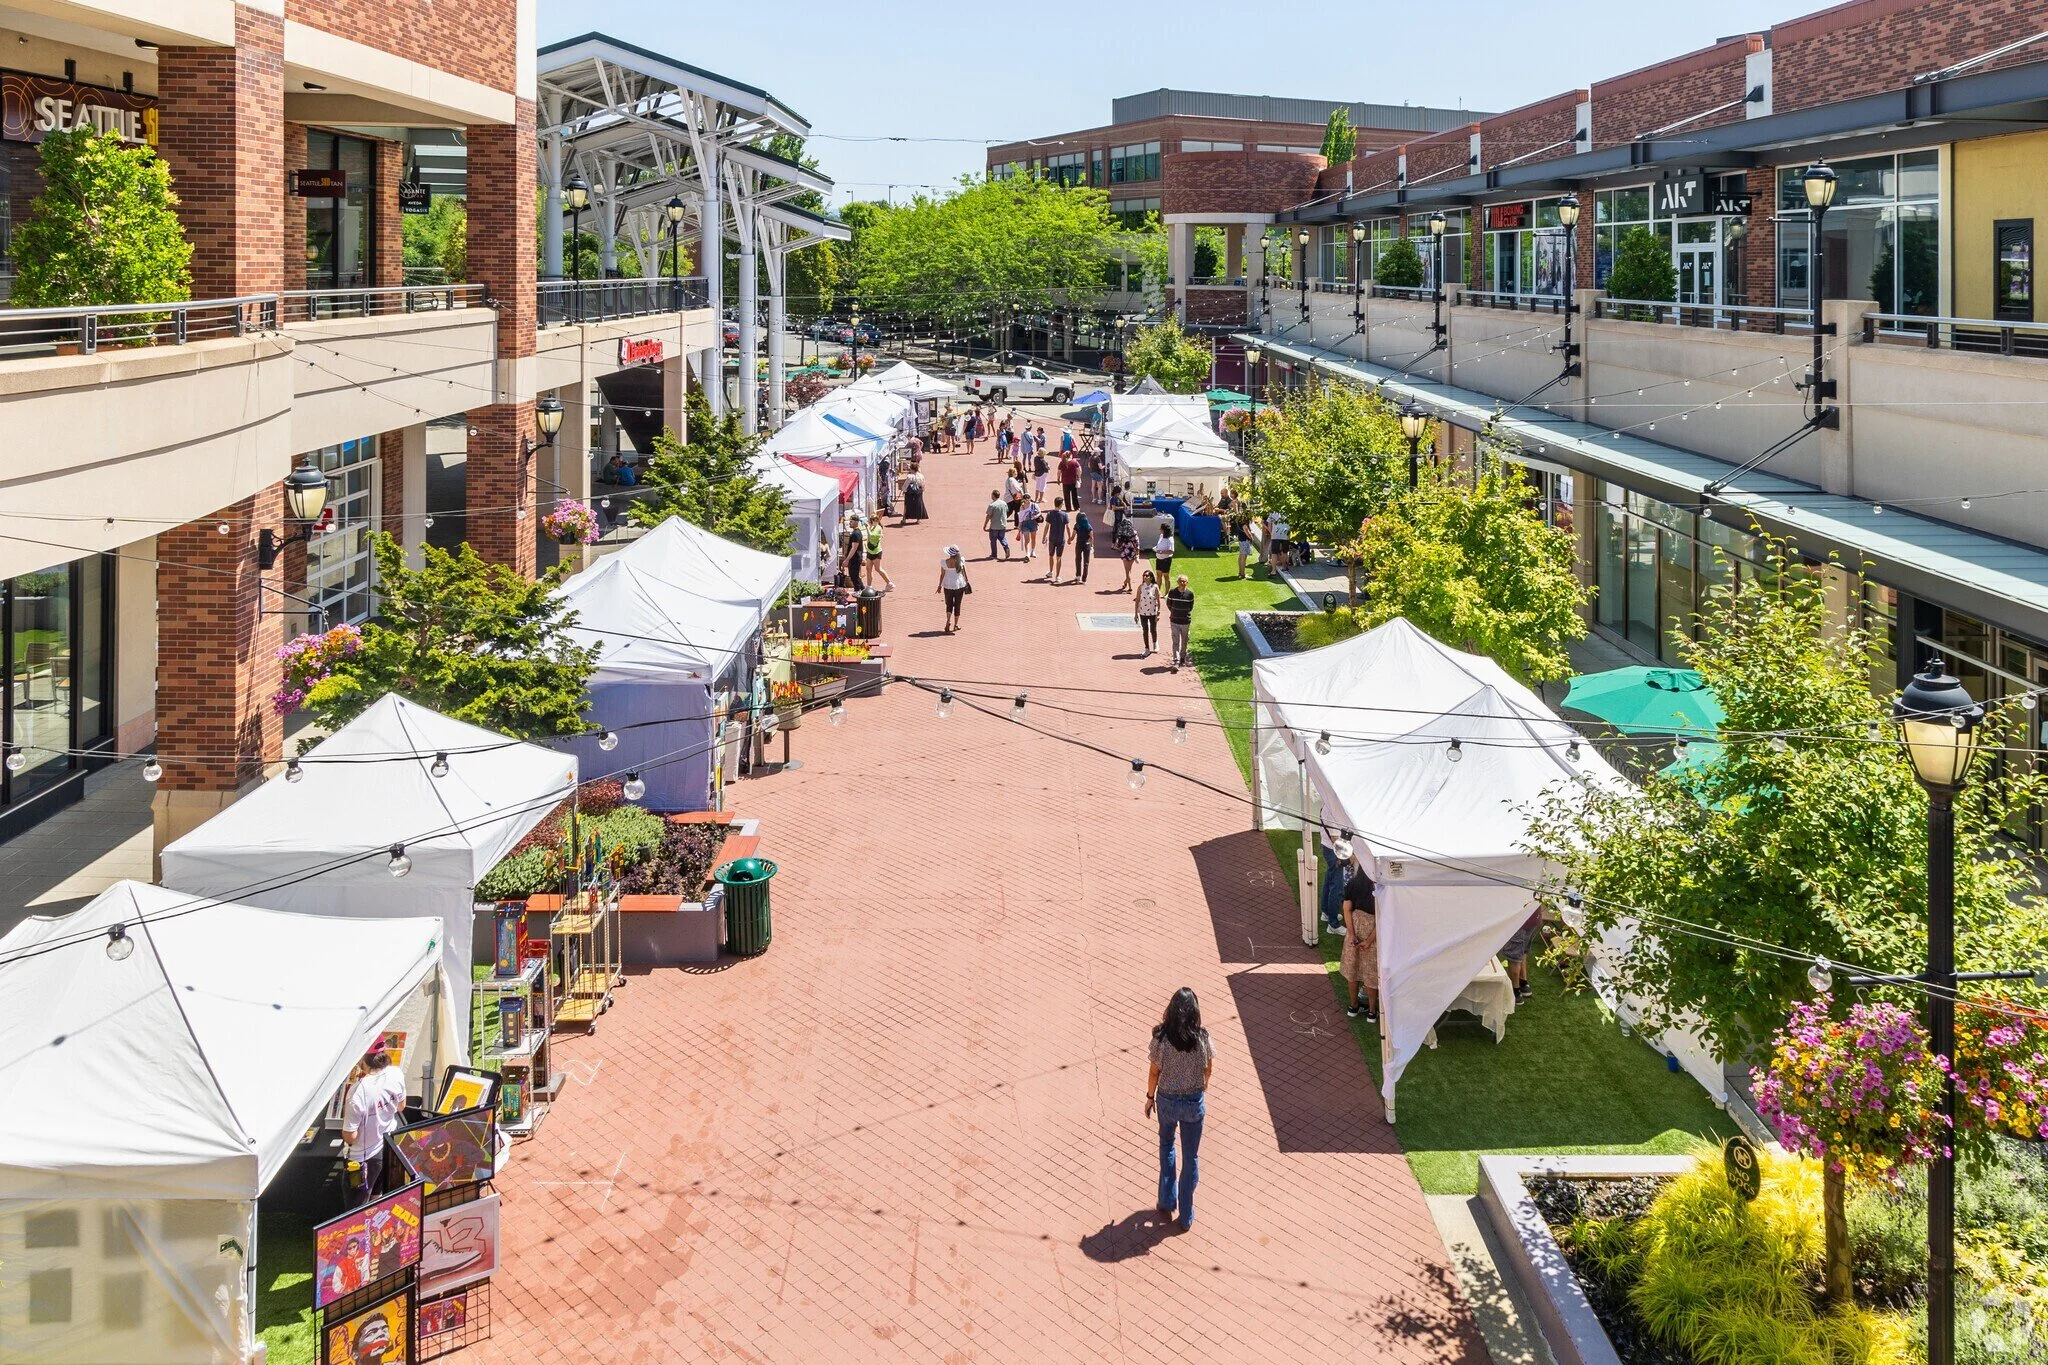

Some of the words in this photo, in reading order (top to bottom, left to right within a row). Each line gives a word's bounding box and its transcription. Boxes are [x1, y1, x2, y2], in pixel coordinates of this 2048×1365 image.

[34, 96, 148, 144] SEATTLE
[1503, 203, 1524, 216] BOXING
[1503, 216, 1518, 227] CLUB
[1735, 1166, 1750, 1182] NO
[1729, 1172, 1755, 1196] DOGS
